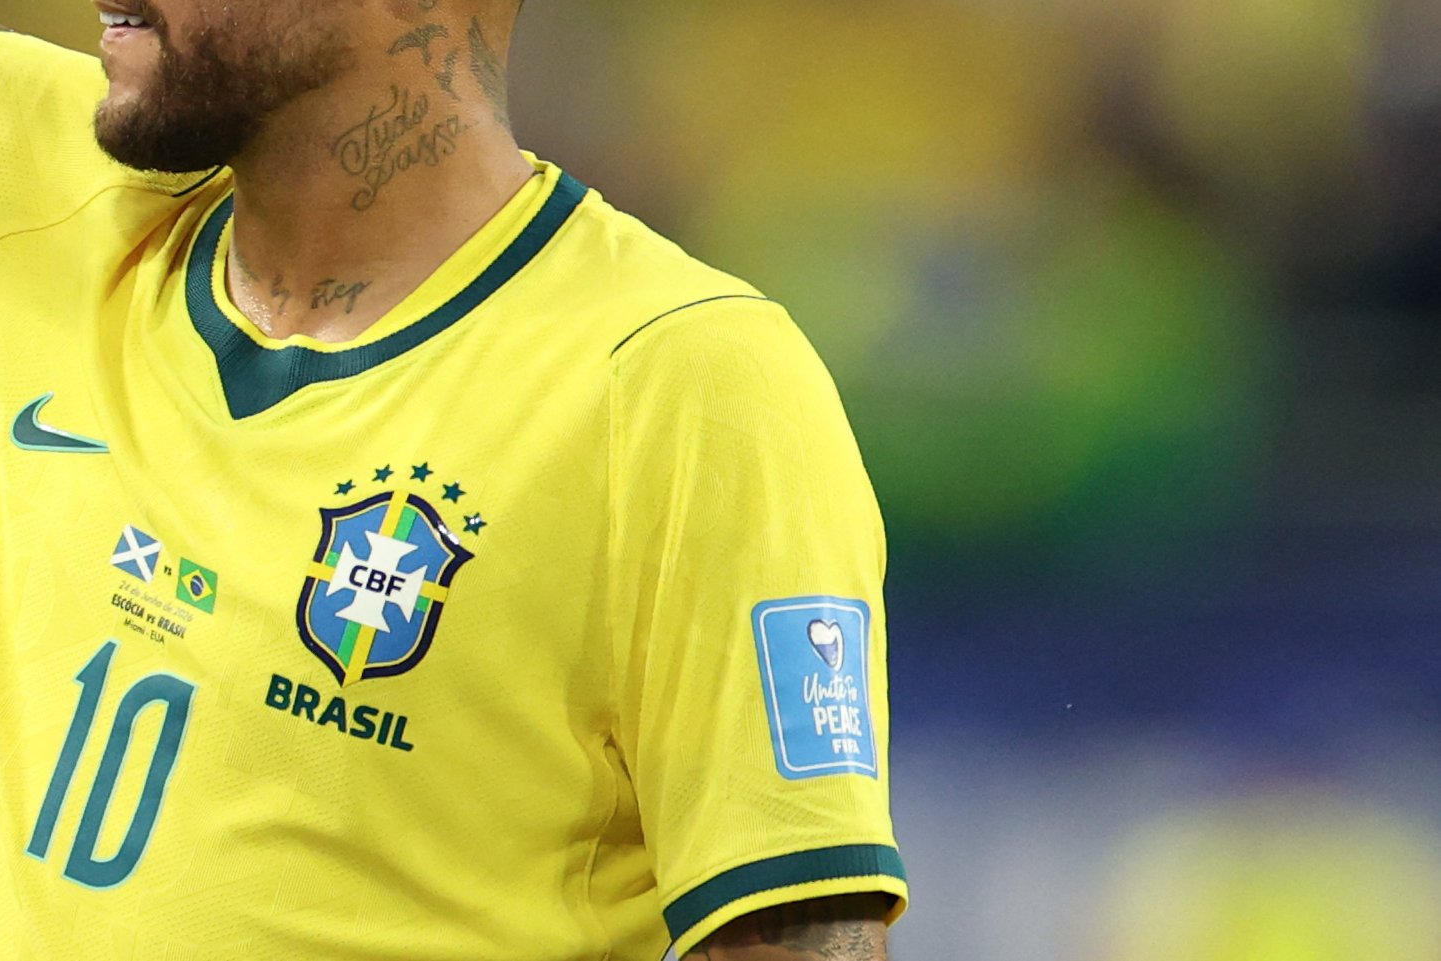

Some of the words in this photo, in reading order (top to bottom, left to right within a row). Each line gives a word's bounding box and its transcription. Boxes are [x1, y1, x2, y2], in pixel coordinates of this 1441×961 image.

[348, 564, 406, 597] CBF
[150, 629, 165, 644] EUA
[158, 616, 186, 639] BRASIL
[265, 673, 414, 752] BRASIL
[25, 639, 198, 890] 10
